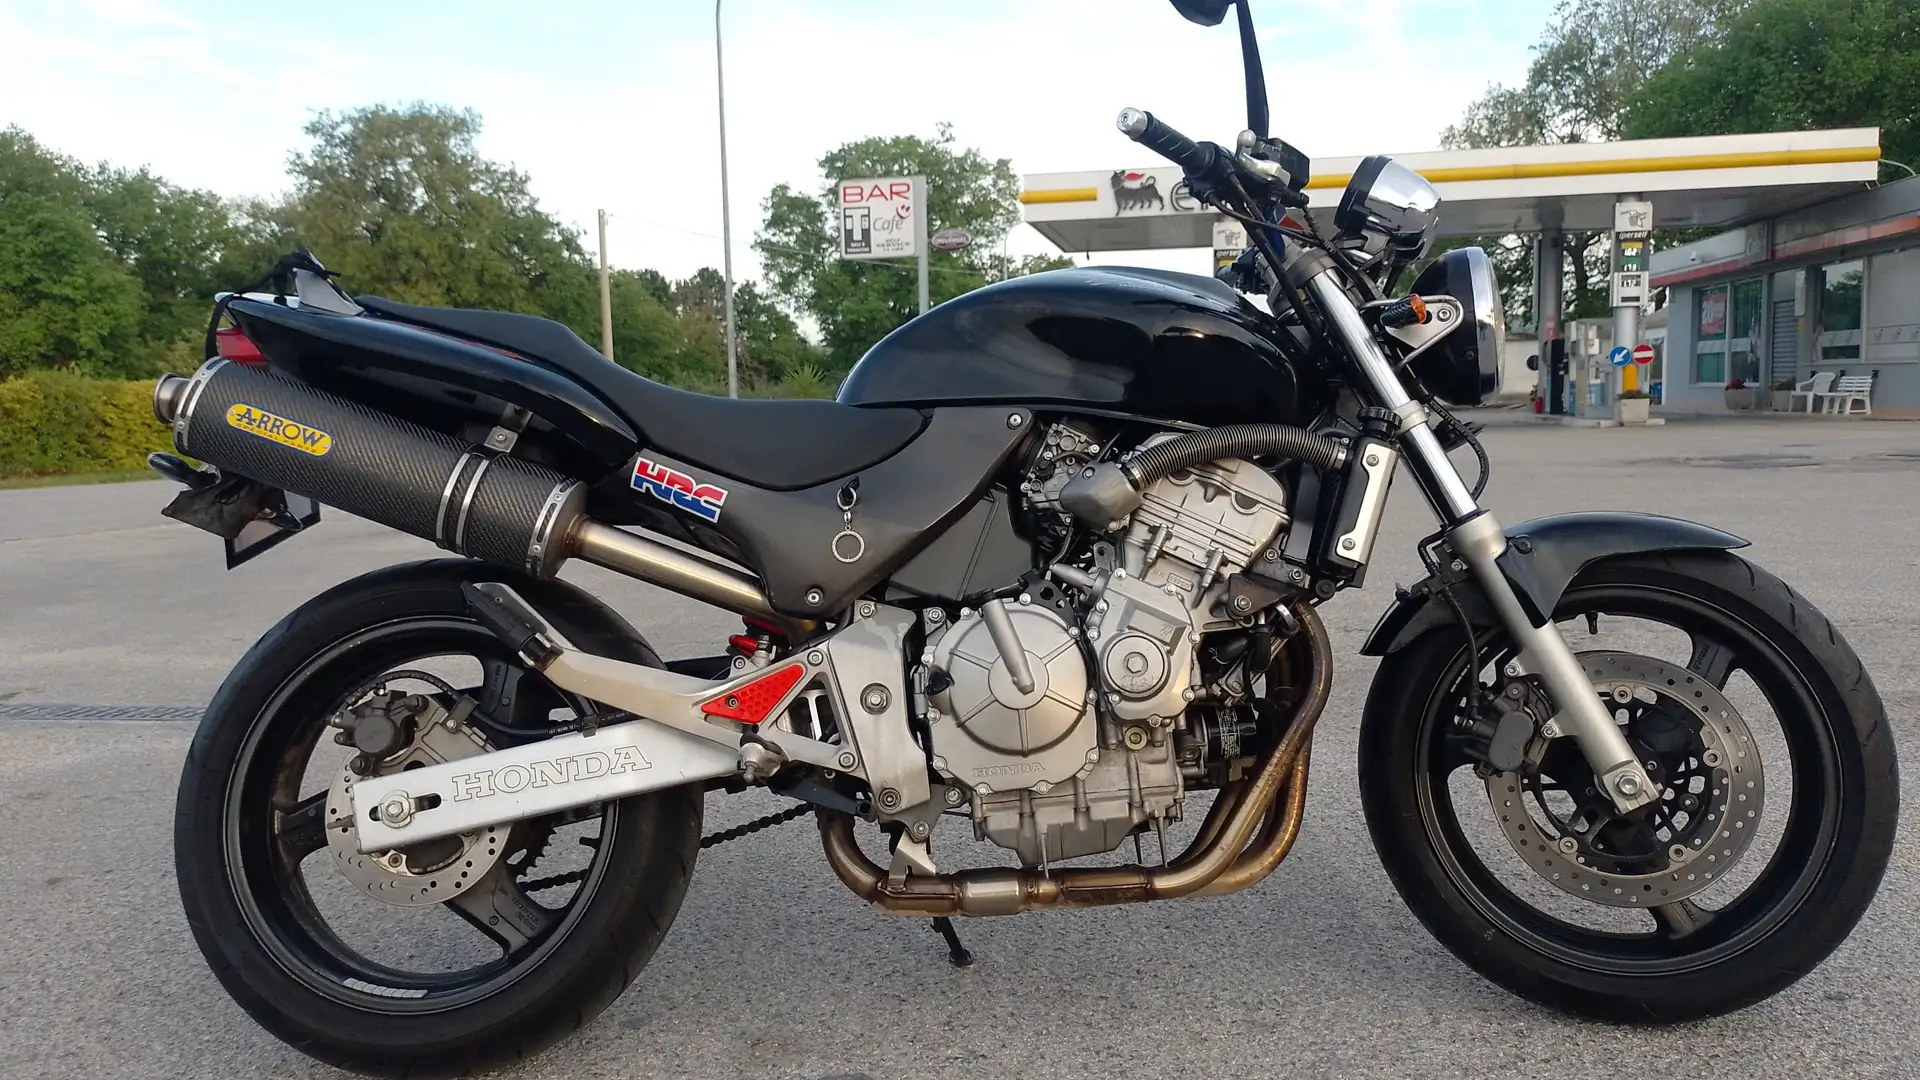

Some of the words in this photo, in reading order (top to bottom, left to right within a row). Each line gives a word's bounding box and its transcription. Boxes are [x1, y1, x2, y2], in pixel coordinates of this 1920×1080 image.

[843, 183, 911, 203] BAR
[872, 215, 904, 234] Café
[236, 408, 326, 448] ARROW
[630, 457, 729, 523] HRC
[452, 745, 653, 802] HONDA
[973, 762, 1046, 778] HONDA
